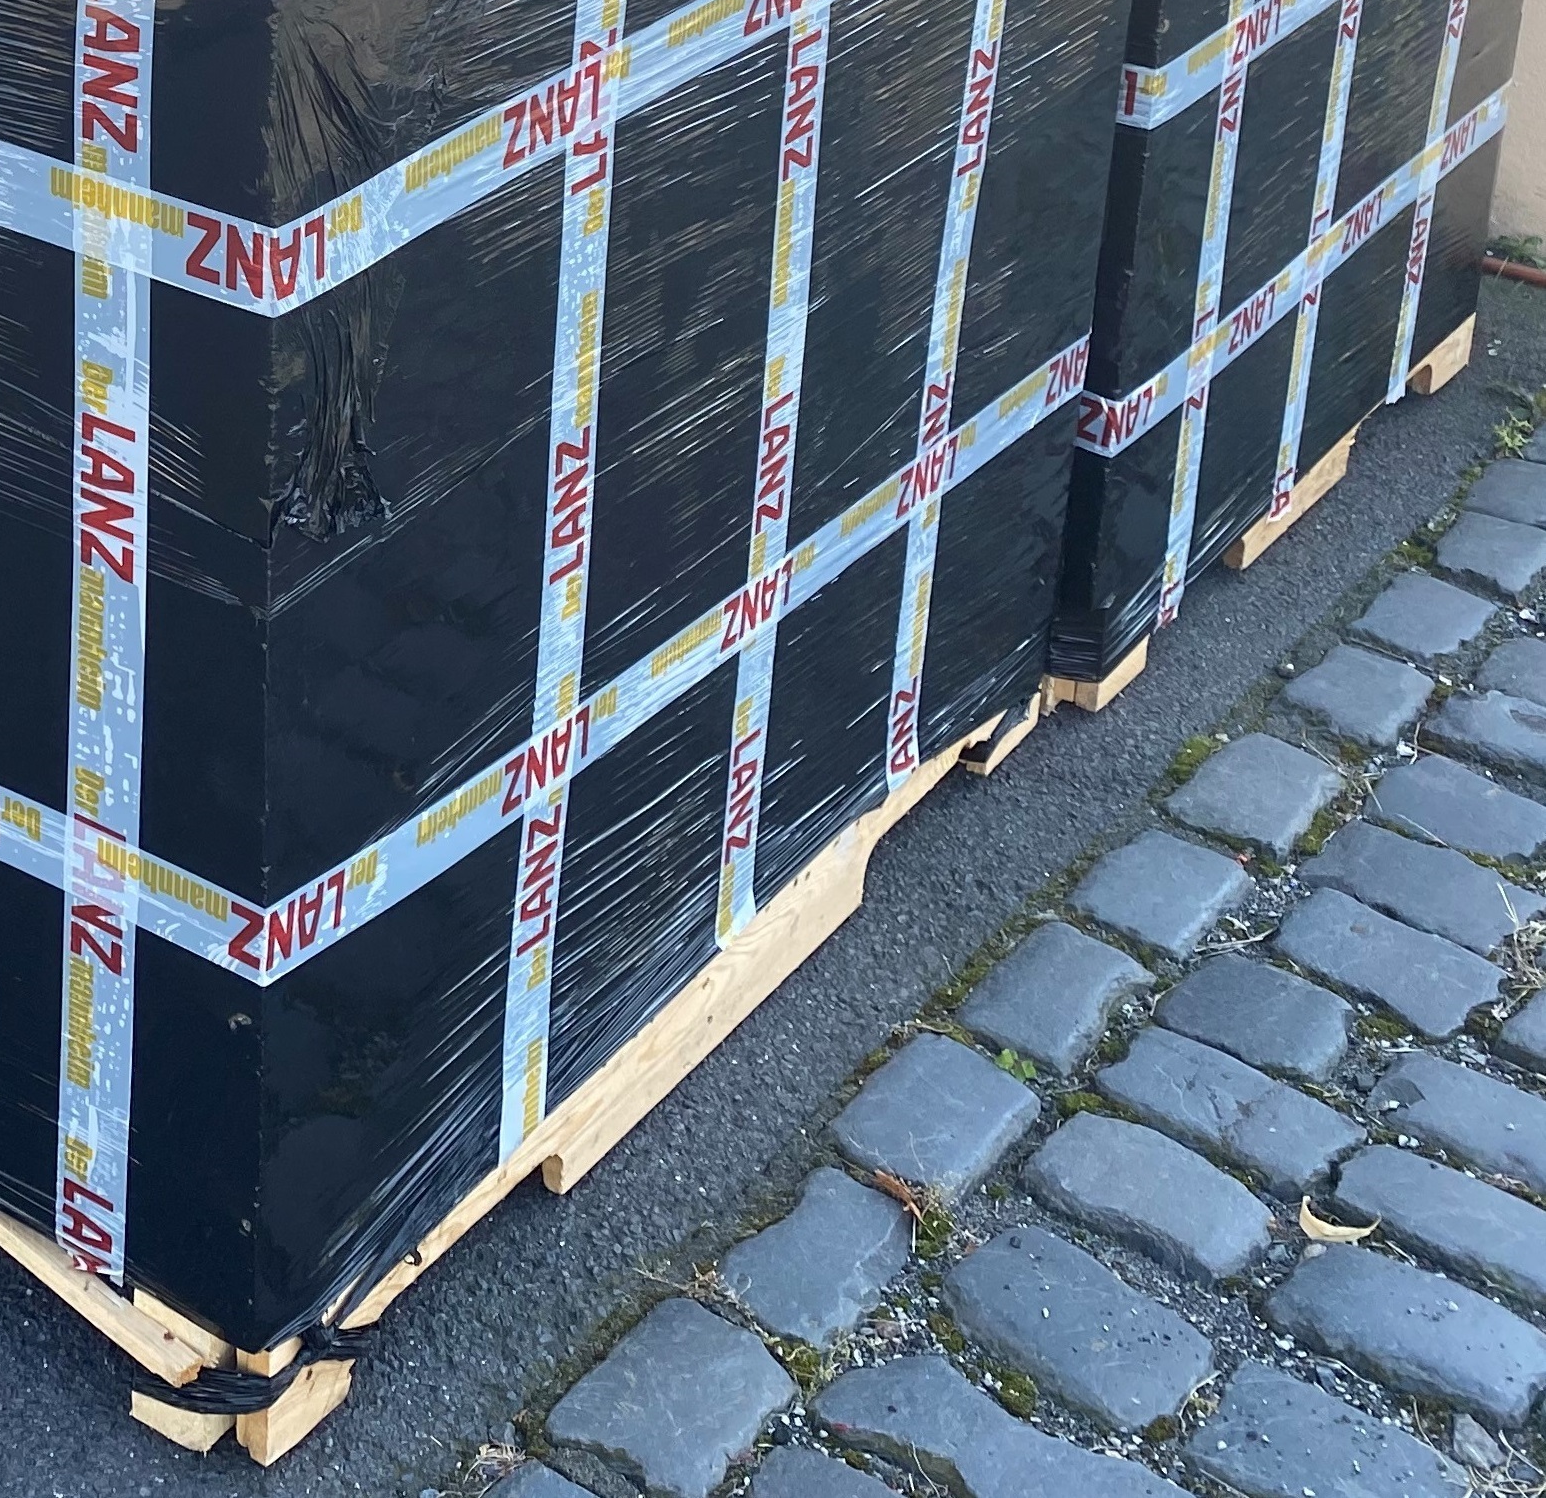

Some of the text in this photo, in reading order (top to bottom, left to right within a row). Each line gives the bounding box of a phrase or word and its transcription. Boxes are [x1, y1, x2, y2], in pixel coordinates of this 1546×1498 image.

[503, 71, 607, 172] LANZ
[781, 29, 822, 180] LANZ
[956, 40, 999, 178] LANZ
[1440, 113, 1479, 169] LANZ
[405, 116, 501, 191] mannheim
[51, 162, 361, 301] Der LANZ mannheim
[1341, 188, 1385, 255] LANZ
[1406, 195, 1436, 287] LANZ
[1228, 285, 1275, 352] LANZ
[755, 392, 793, 532] LANZ
[1077, 386, 1154, 447] LANZ
[549, 426, 590, 585] LANZ
[896, 430, 958, 517] LANZ
[78, 362, 136, 709] Der LANZ mannheim
[721, 560, 793, 651] LANZ
[75, 767, 104, 815] Der
[417, 771, 502, 844] mannheim
[501, 707, 590, 819] LANZ
[724, 729, 761, 863] LANZ
[2, 801, 41, 840] Der
[96, 838, 377, 970] Der LANZ mannheim
[516, 804, 562, 956] LANZ
[69, 958, 95, 1087] mannheim
[66, 1137, 93, 1178] Der
